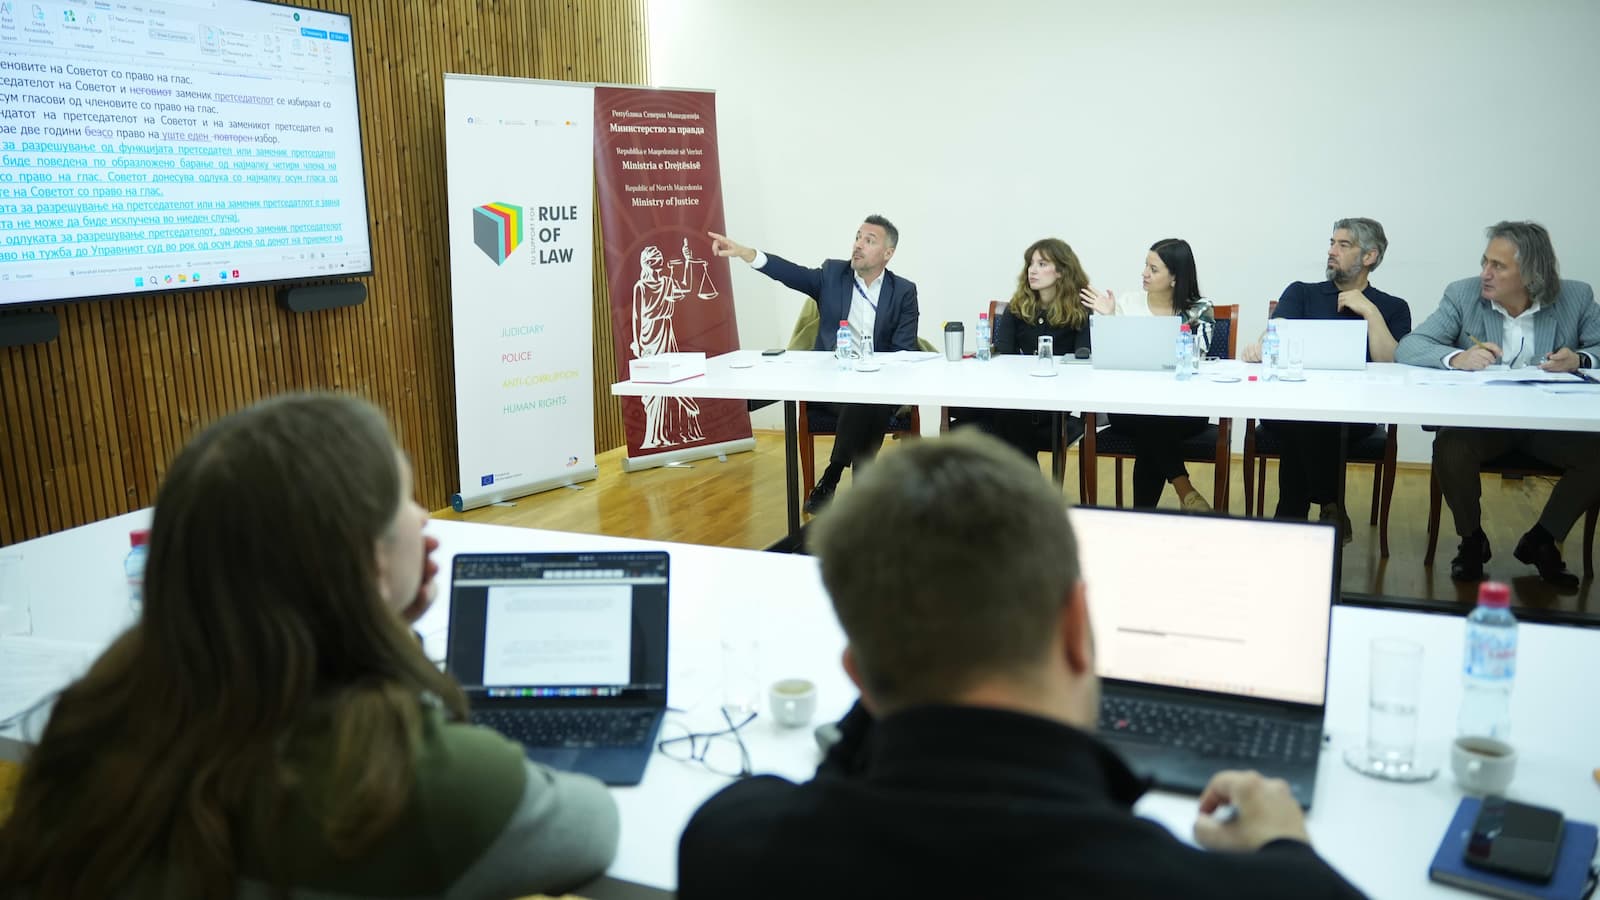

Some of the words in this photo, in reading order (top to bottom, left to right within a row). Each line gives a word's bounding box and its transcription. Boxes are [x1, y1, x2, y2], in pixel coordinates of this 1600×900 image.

[50, 65, 63, 74] на
[66, 64, 108, 78] Советот
[111, 70, 122, 79] со
[125, 71, 154, 82] право
[157, 74, 168, 83] на
[170, 75, 193, 85] глас.
[59, 81, 72, 90] на
[75, 80, 116, 94] Советот
[120, 86, 126, 94] и
[129, 86, 172, 97] неговиот
[175, 89, 212, 100] заменик
[213, 92, 274, 105] претседателот
[22, 93, 66, 105] гласови
[68, 97, 82, 107] од
[85, 98, 138, 110] членовите
[140, 102, 151, 110] со
[154, 103, 182, 113] право
[197, 105, 219, 114] глас.
[43, 111, 57, 120] на
[63, 111, 137, 124] претседателот
[143, 116, 155, 125] на
[161, 115, 196, 126] Советот
[228, 121, 270, 130] заменикот
[275, 123, 321, 133] претседател
[610, 123, 667, 135] Министерство
[677, 127, 704, 136] правда
[21, 126, 40, 136] две
[44, 127, 82, 137] години
[117, 129, 145, 140] право
[148, 131, 160, 139] на
[162, 131, 185, 142] уште
[188, 133, 209, 142] еден
[3, 141, 15, 150] за
[22, 142, 96, 153] разрешување
[101, 144, 113, 153] од
[119, 142, 173, 155] функцијата
[178, 145, 232, 156] претседател
[3, 155, 30, 166] биде
[37, 157, 87, 167] поведена
[94, 158, 106, 167] по
[112, 157, 175, 168] образложено
[180, 158, 213, 169] барање
[218, 160, 229, 168] од
[622, 160, 657, 170] Ministria
[665, 160, 701, 172] Drejtësisë
[19, 173, 52, 183] право
[58, 173, 71, 181] на
[107, 172, 147, 181] Советот
[153, 173, 194, 182] донесува
[199, 174, 228, 183] одлука
[14, 188, 27, 197] на
[31, 186, 74, 197] Советот
[78, 188, 89, 197] со
[93, 188, 122, 198] право
[126, 187, 137, 196] на
[625, 184, 648, 192] Republic
[21, 204, 33, 213] за
[37, 203, 108, 214] разрешување
[112, 202, 123, 210] на
[127, 201, 194, 212] претседателот
[197, 201, 213, 209] или
[216, 201, 225, 209] на
[632, 197, 664, 208] Ministry
[665, 197, 673, 206] of
[674, 197, 699, 206] Justice
[539, 205, 577, 221] RULE
[17, 220, 31, 228] не
[34, 218, 64, 227] може
[67, 218, 80, 228] да
[83, 216, 107, 227] биде
[111, 216, 160, 227] исклучена
[163, 215, 174, 223] во
[6, 234, 57, 246] одлуката
[61, 233, 73, 242] за
[77, 230, 145, 243] разрешување
[539, 228, 561, 243] OF
[22, 250, 35, 260] на
[40, 247, 72, 261] тужба
[76, 248, 89, 257] до
[91, 245, 144, 258] Управниот
[147, 243, 163, 253] суд
[166, 243, 176, 252] во
[179, 242, 195, 252] рок
[198, 242, 208, 251] од
[211, 240, 231, 250] осум
[255, 238, 265, 247] од
[539, 248, 574, 265] LAW
[502, 324, 545, 338] JUDICIARY
[502, 351, 532, 363] POLICE
[503, 400, 536, 414] HUMAN
[538, 396, 567, 409] RIGHTS
